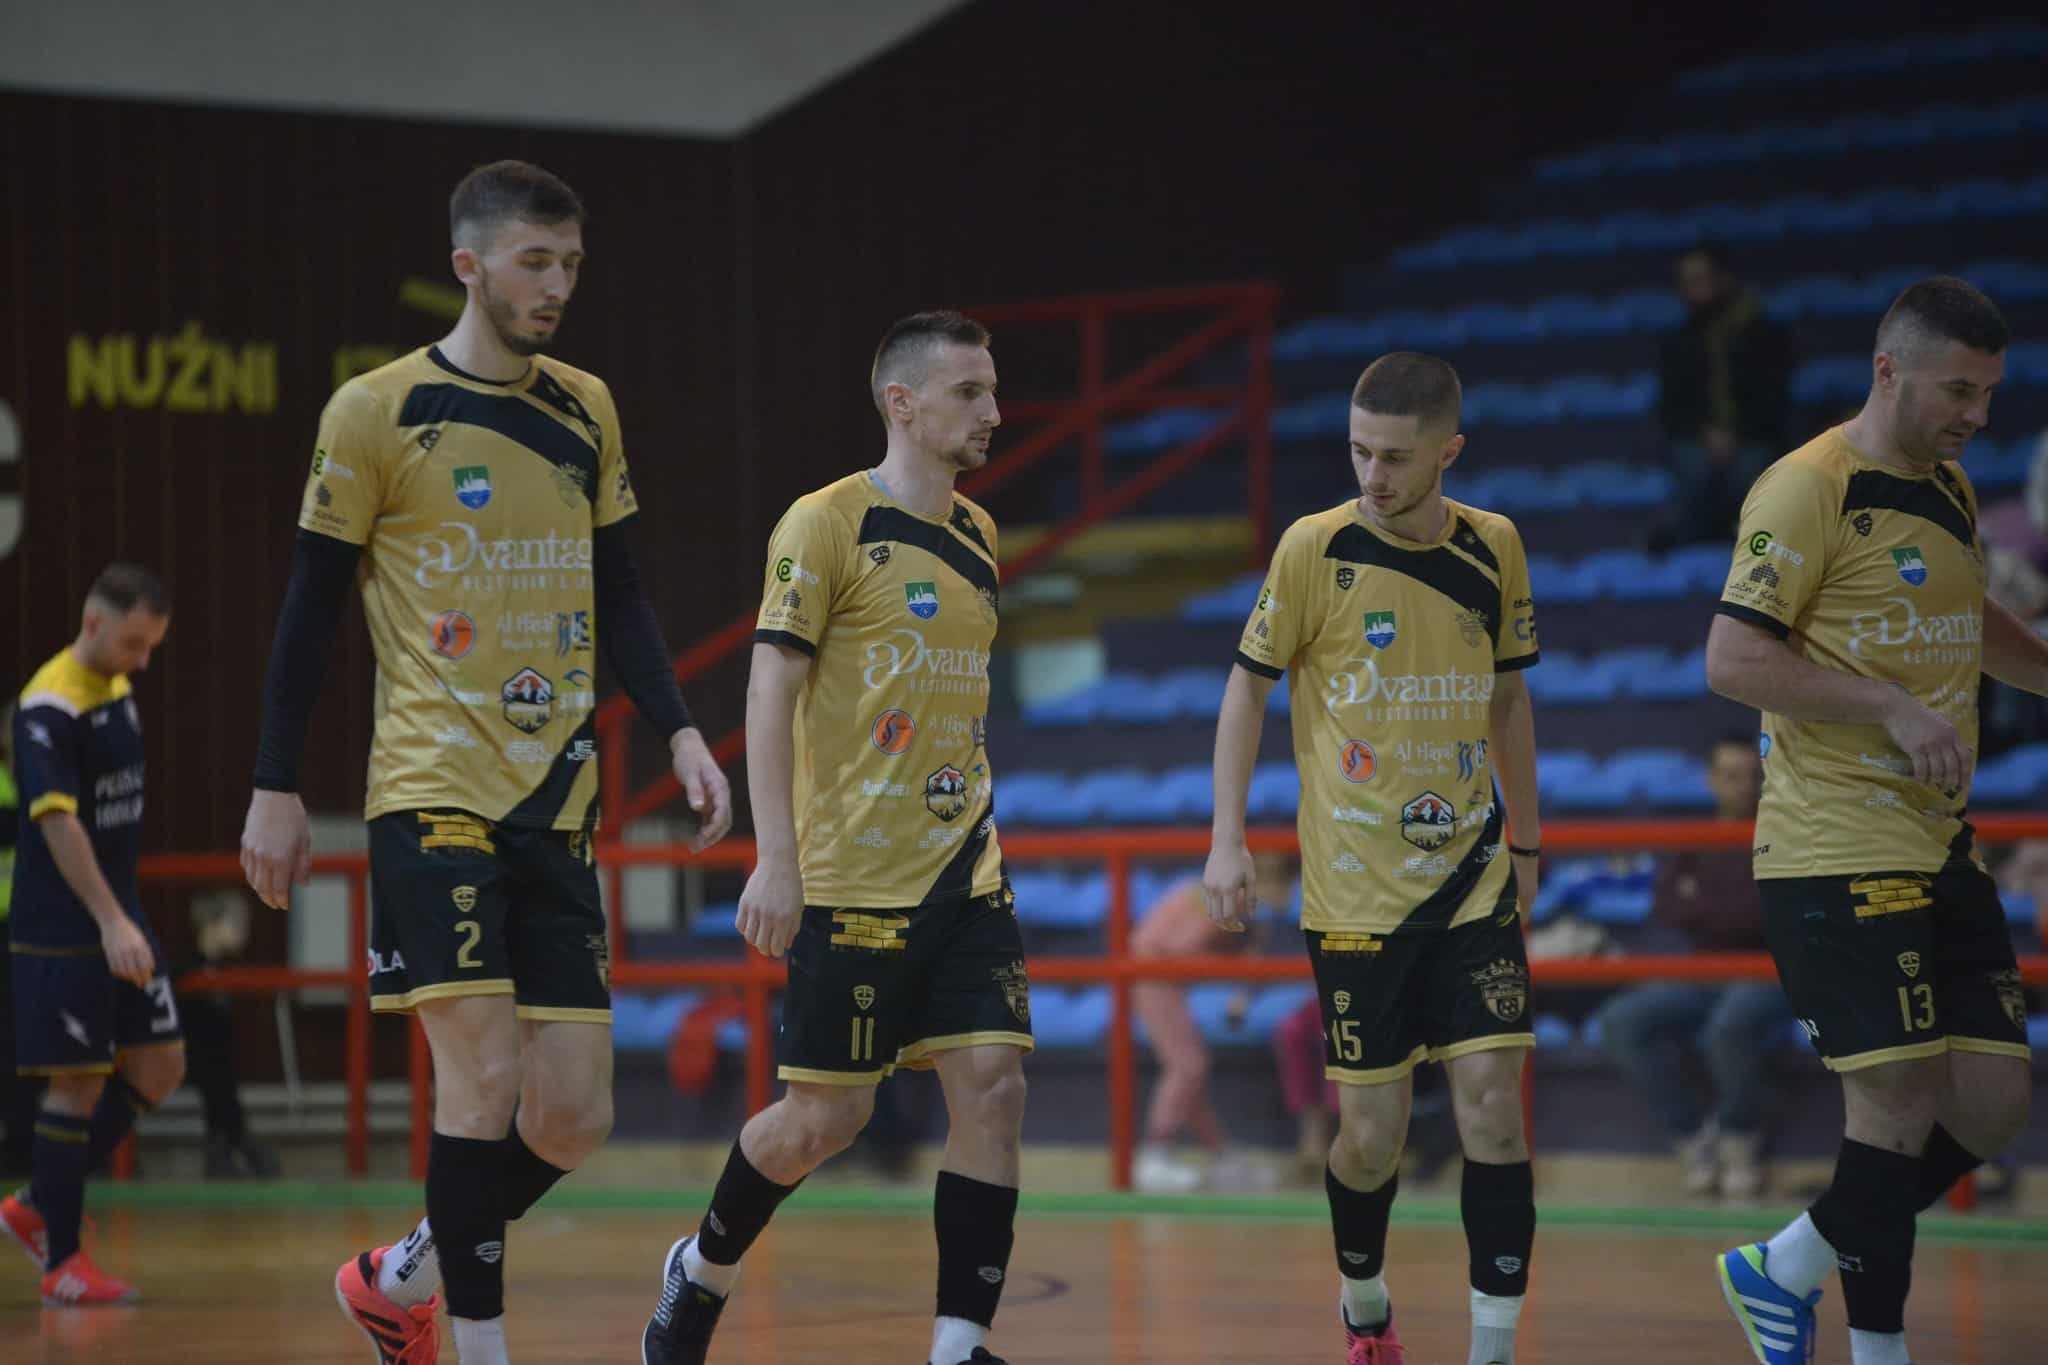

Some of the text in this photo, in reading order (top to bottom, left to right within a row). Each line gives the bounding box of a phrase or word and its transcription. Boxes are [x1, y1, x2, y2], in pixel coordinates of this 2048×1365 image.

[66, 320, 279, 415] NUŽNI
[454, 919, 483, 968] 2
[1897, 984, 1936, 1032] 13
[851, 1016, 874, 1061] 11
[1332, 1019, 1362, 1061] 15
